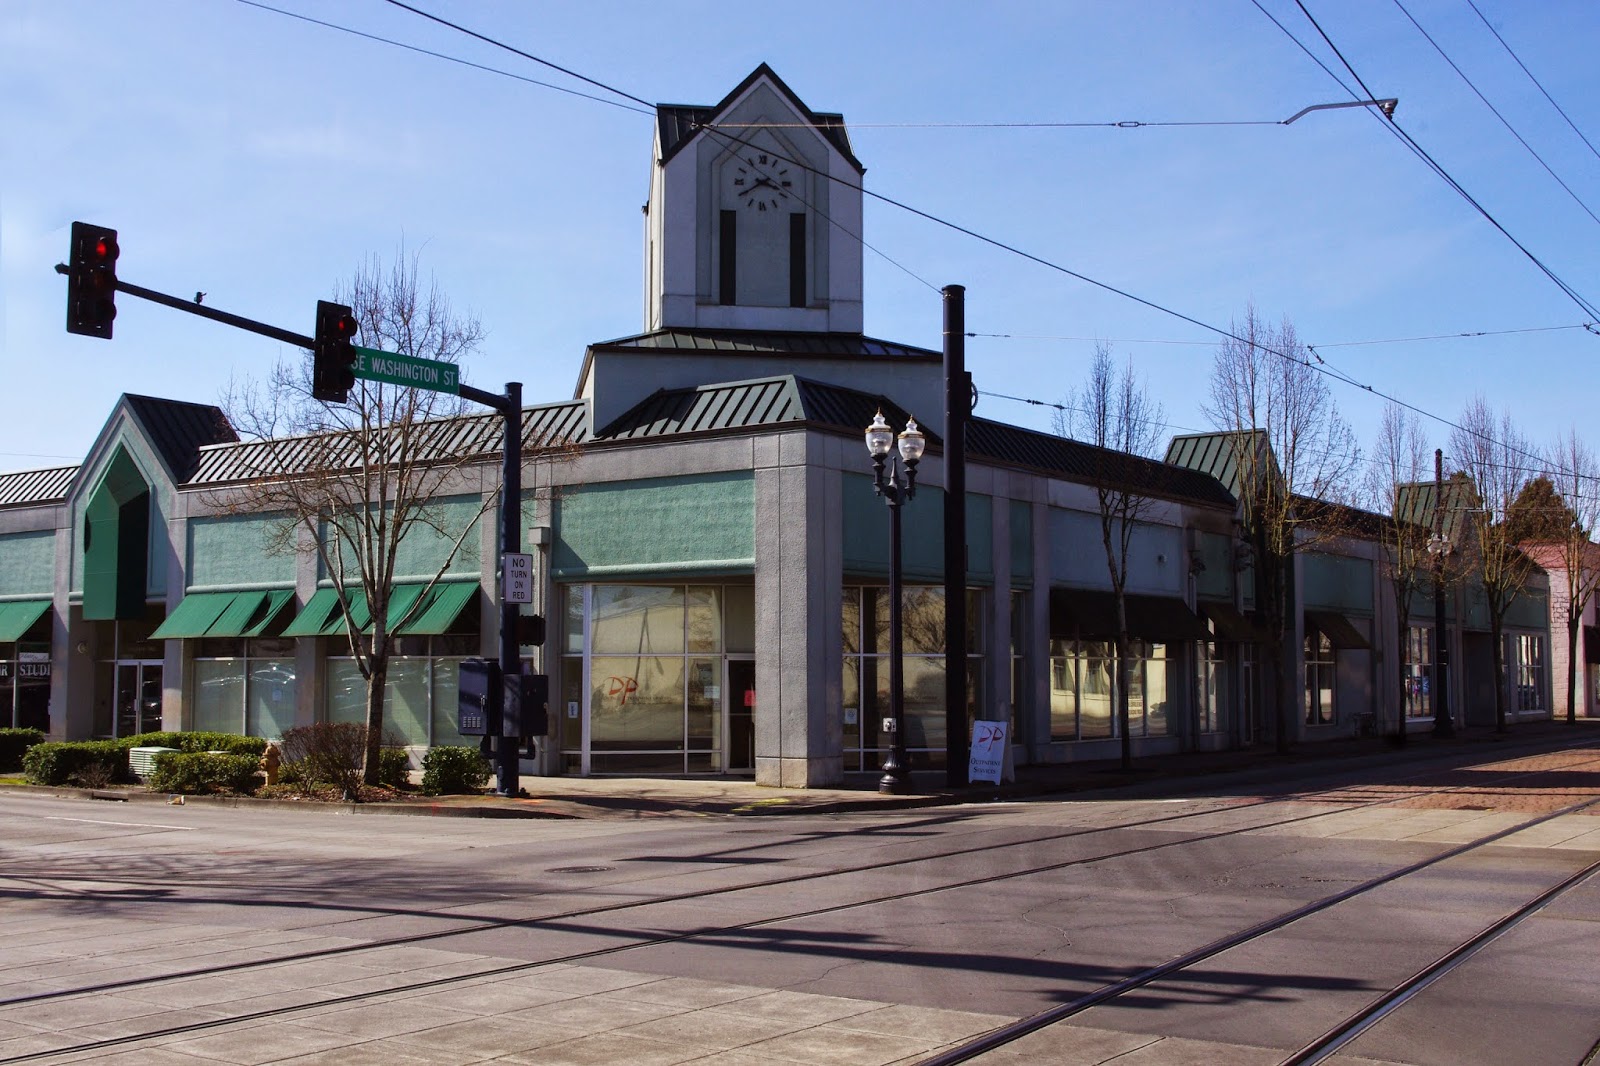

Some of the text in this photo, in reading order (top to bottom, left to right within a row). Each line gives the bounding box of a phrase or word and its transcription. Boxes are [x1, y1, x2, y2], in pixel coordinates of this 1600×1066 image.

[350, 355, 456, 386] SE WASHINGTON ST
[512, 558, 525, 568] NO
[511, 570, 527, 578] TURN
[514, 580, 523, 589] ON
[512, 591, 525, 600] RED
